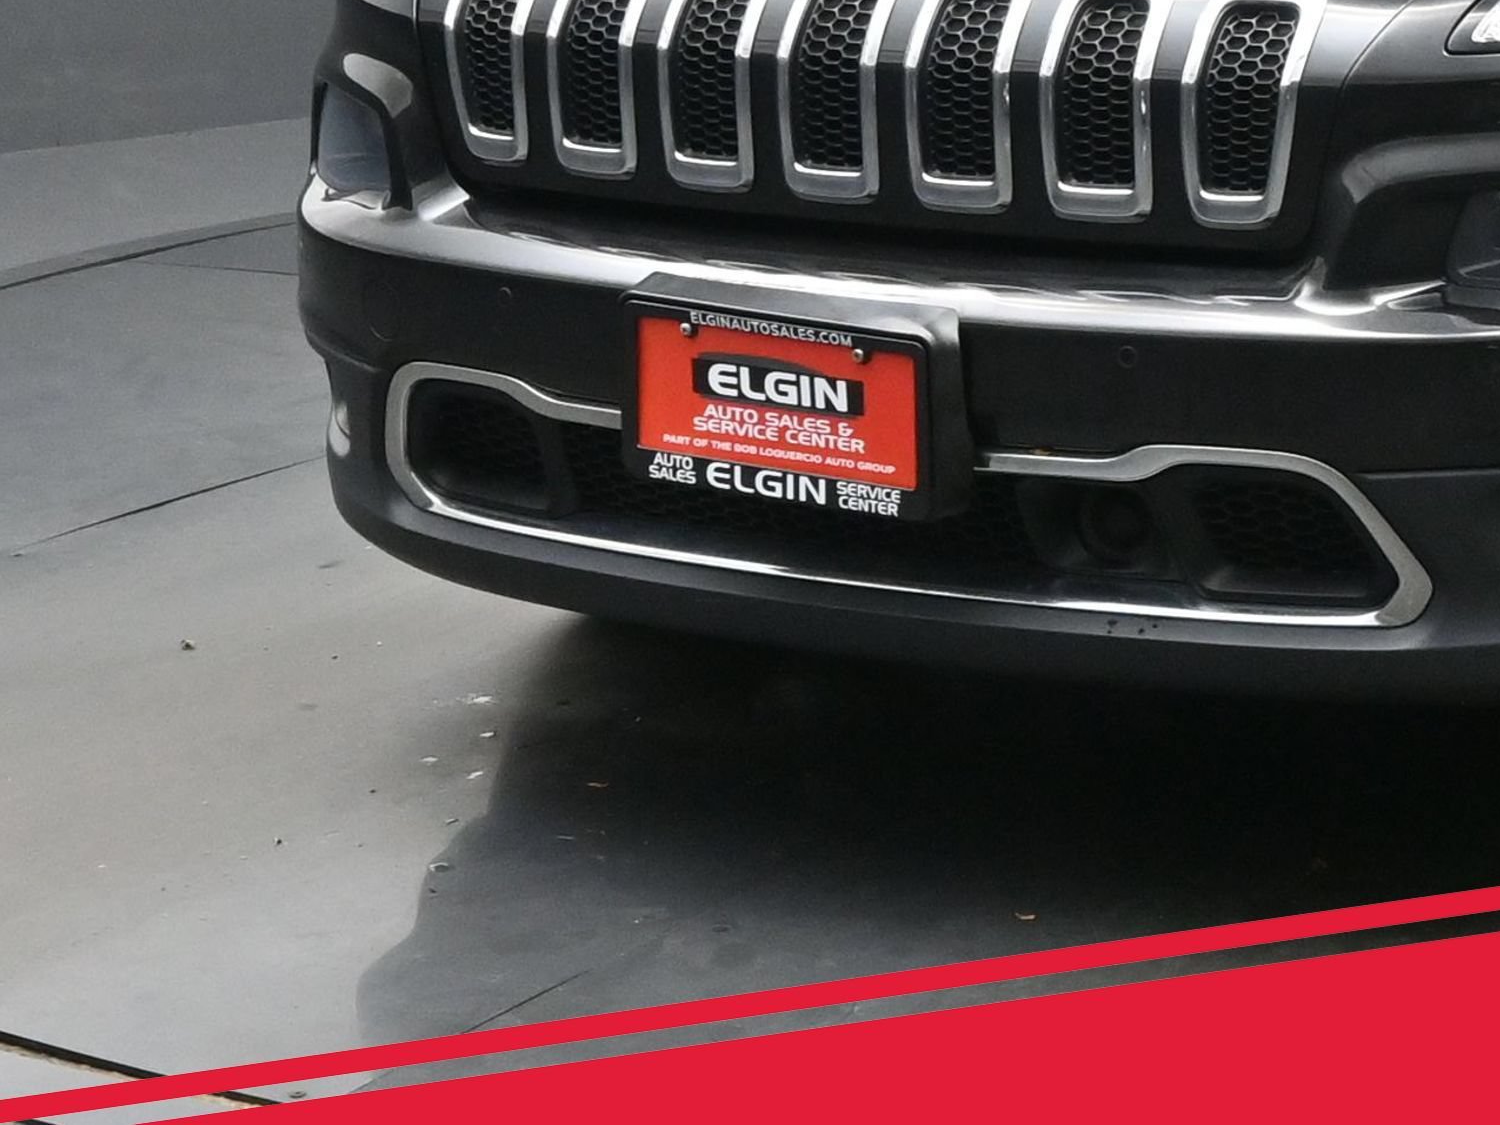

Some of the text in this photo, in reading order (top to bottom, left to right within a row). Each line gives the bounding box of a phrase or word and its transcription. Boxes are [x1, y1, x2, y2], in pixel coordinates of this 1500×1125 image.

[689, 310, 853, 347] ELGINAUTOSALES.COM
[707, 362, 849, 413] ELGIN
[692, 415, 866, 455] SERVICE CENTER
[703, 403, 855, 437] AUTO SALES &
[652, 451, 694, 471] AUTO
[662, 433, 692, 447] PART
[693, 437, 710, 448] OF
[711, 439, 733, 452] THE
[824, 456, 855, 469] AUTO
[856, 460, 897, 475] GROUP
[648, 464, 698, 485] SALES
[705, 461, 827, 506] ELGIN
[835, 480, 902, 504] SERVICE
[838, 495, 899, 518] CENTER
